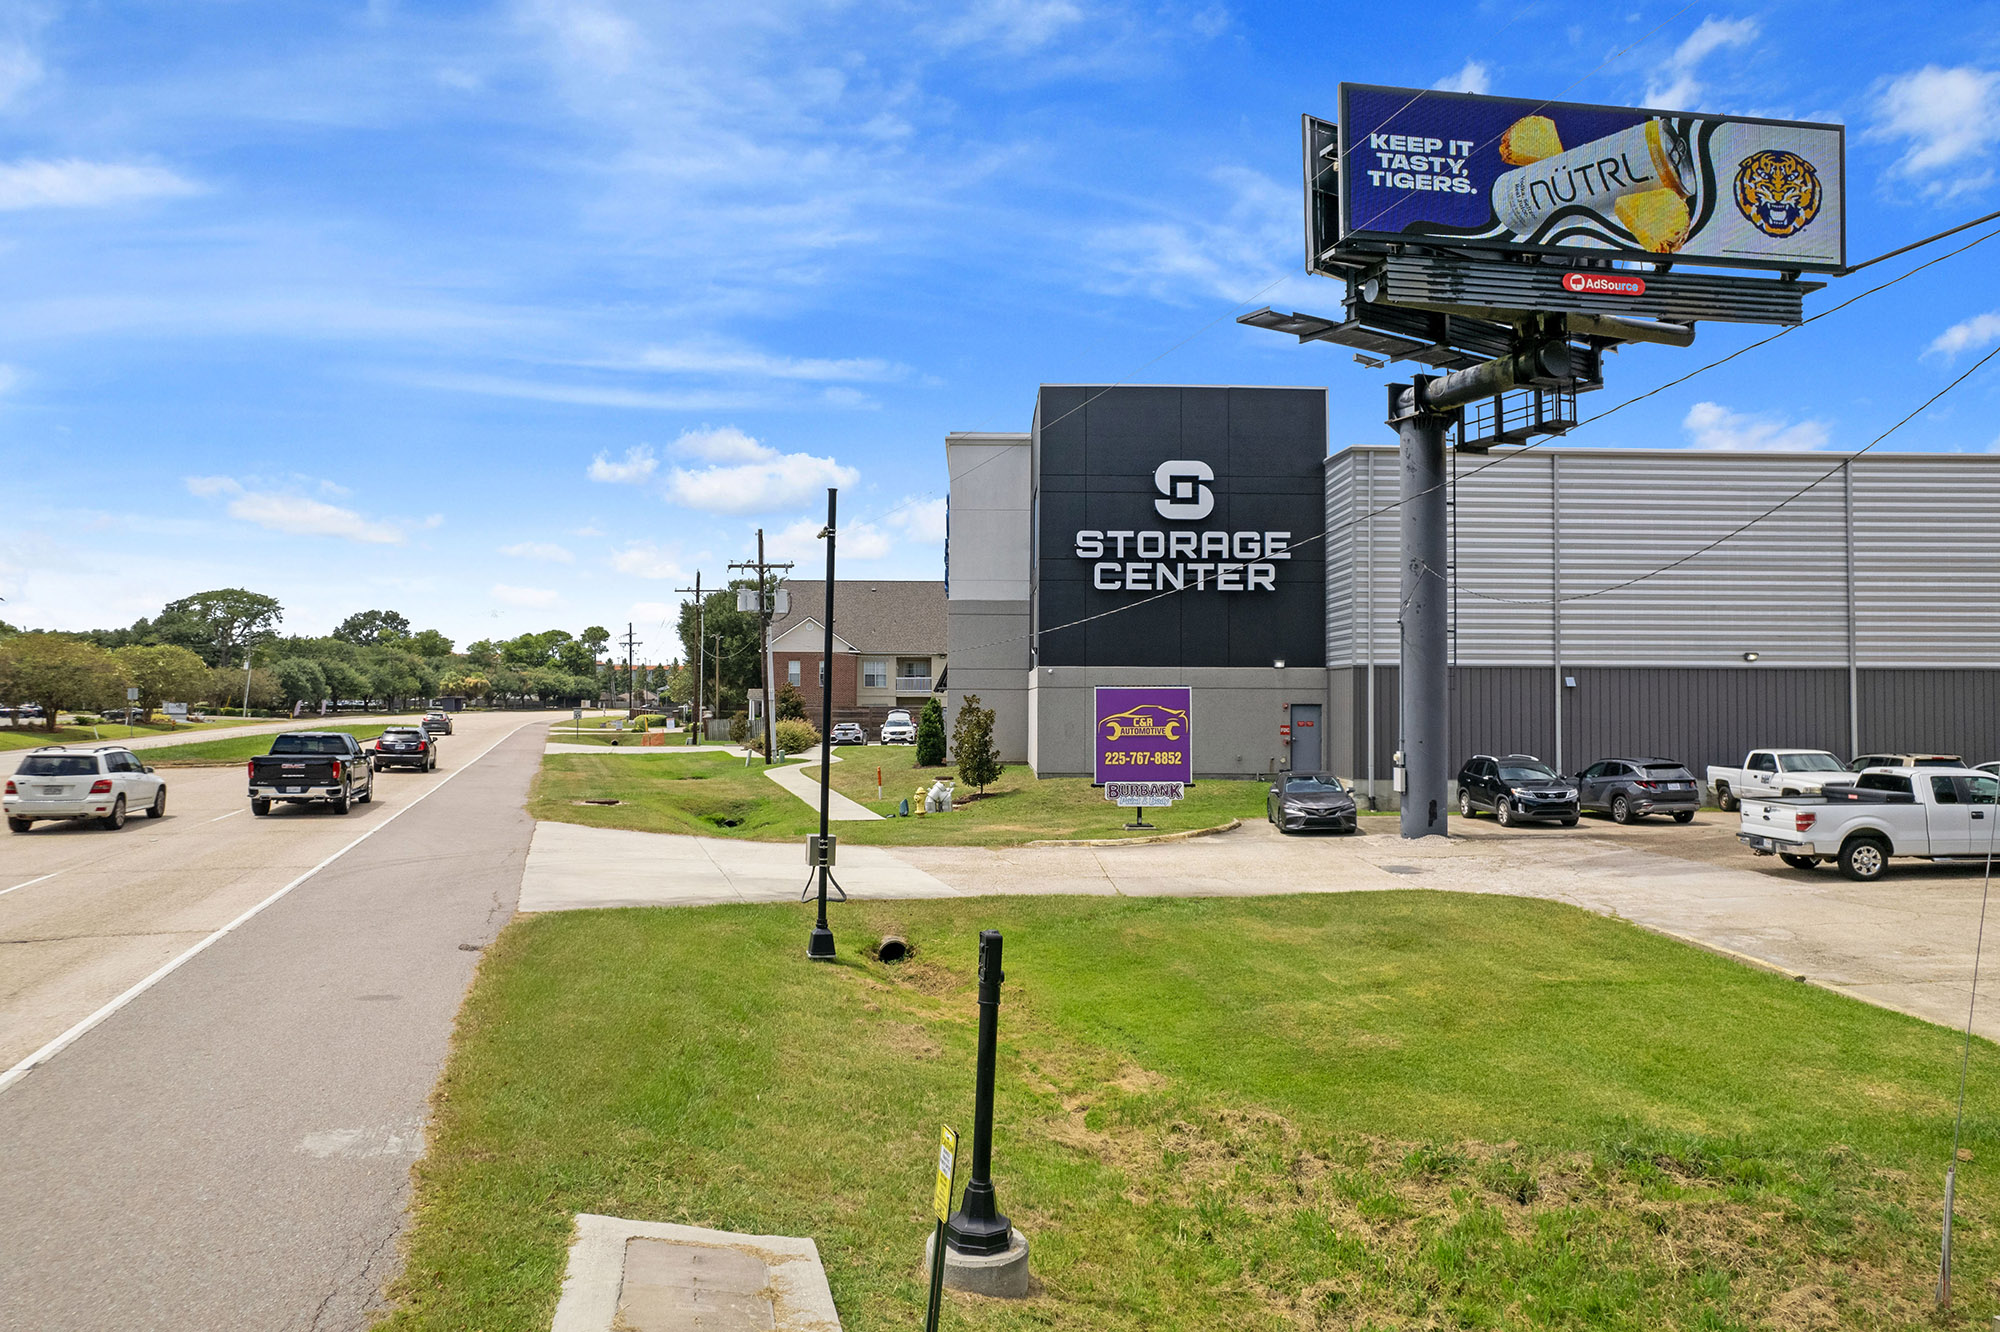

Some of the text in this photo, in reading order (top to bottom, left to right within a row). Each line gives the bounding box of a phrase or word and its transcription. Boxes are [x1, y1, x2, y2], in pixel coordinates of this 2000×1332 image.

[1370, 133, 1474, 156] KEEP IT
[1376, 152, 1468, 177] TASTY,
[1367, 170, 1477, 194] TIGERS.
[1586, 279, 1638, 291] AdSource
[1076, 530, 1291, 559] STORAGE
[1093, 562, 1276, 591] CENTER
[1120, 727, 1166, 735] AUTOMOTIVE
[1133, 718, 1153, 727] C&R
[1105, 752, 1182, 765] 225-767-8852
[1108, 784, 1182, 799] BURBANK
